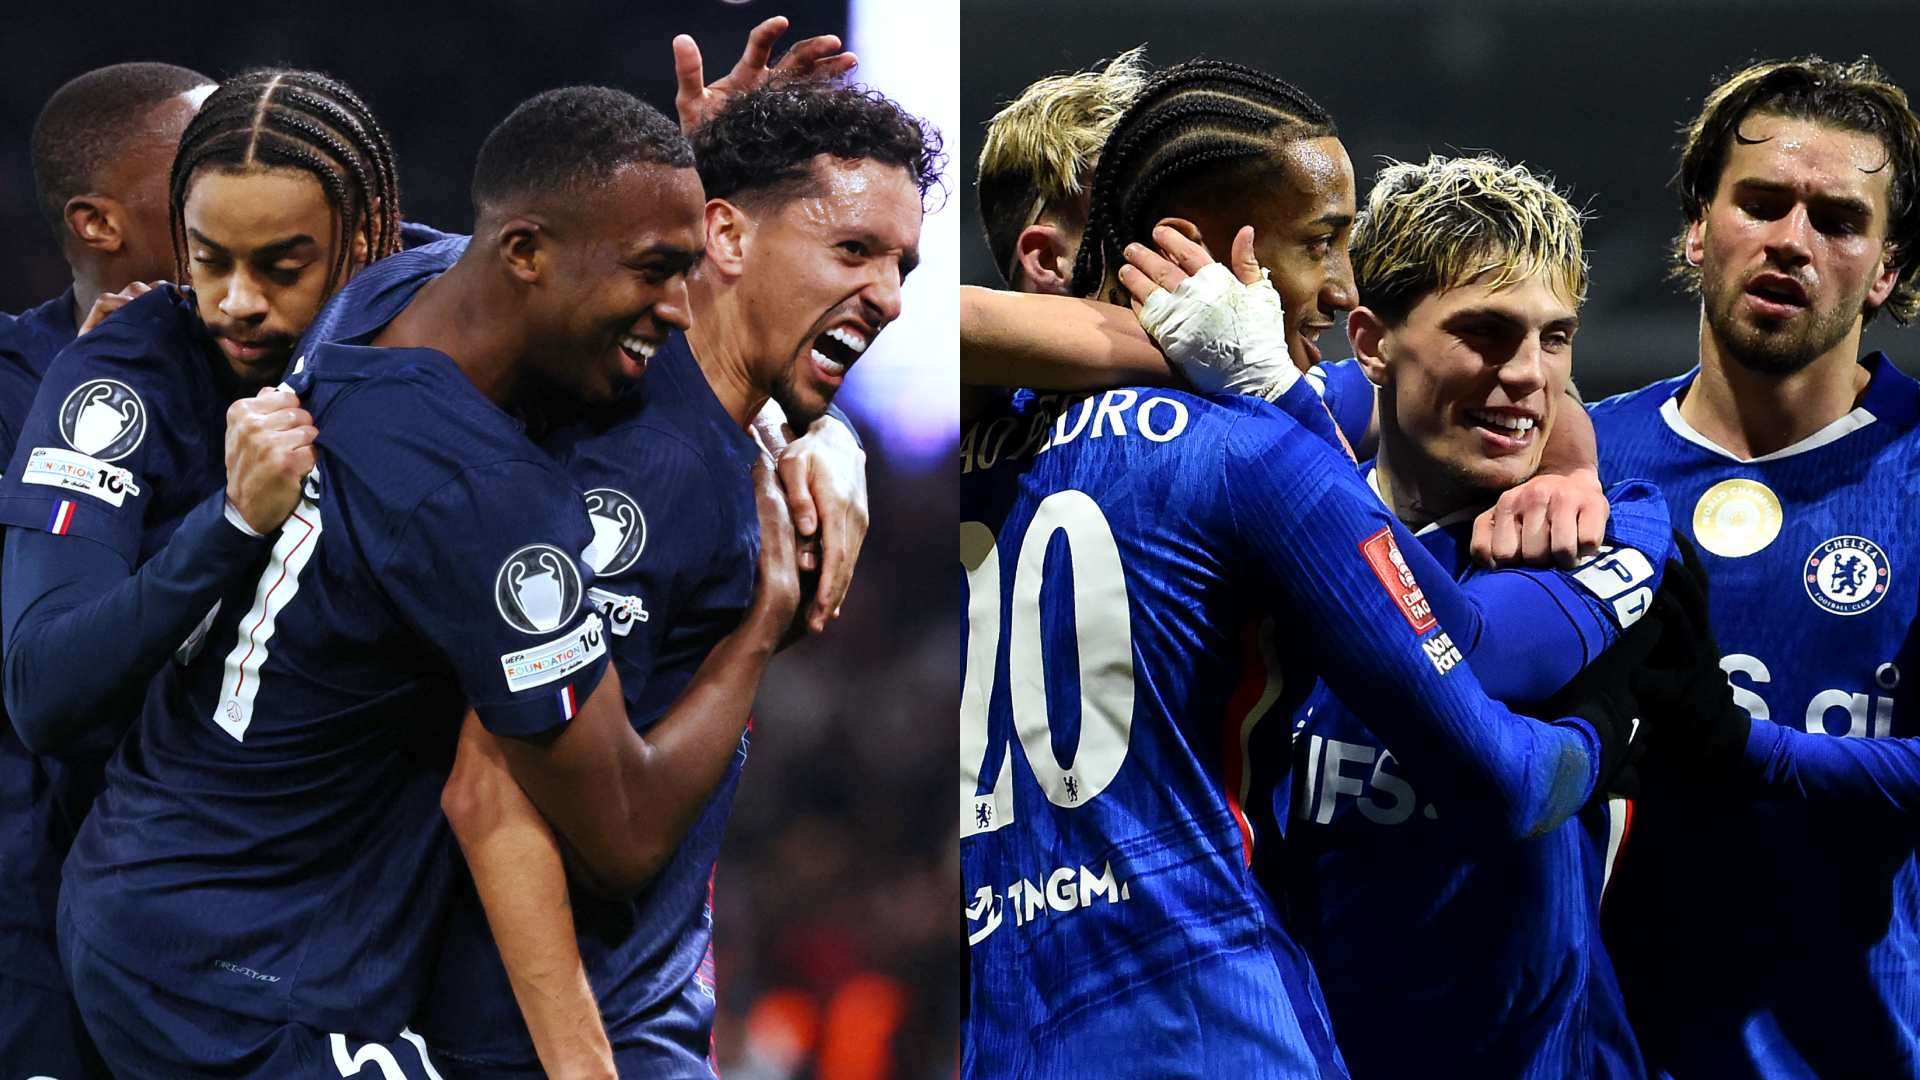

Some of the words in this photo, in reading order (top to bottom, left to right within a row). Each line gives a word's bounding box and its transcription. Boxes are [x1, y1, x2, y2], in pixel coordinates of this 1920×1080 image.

[98, 468, 124, 494] 10
[1825, 539, 1878, 559] CHELSEA
[604, 601, 632, 624] 10
[1815, 593, 1848, 611] FOOTBALL
[1852, 599, 1871, 610] CLUB
[505, 655, 525, 664] UEFA
[506, 645, 580, 677] FOUNDATION
